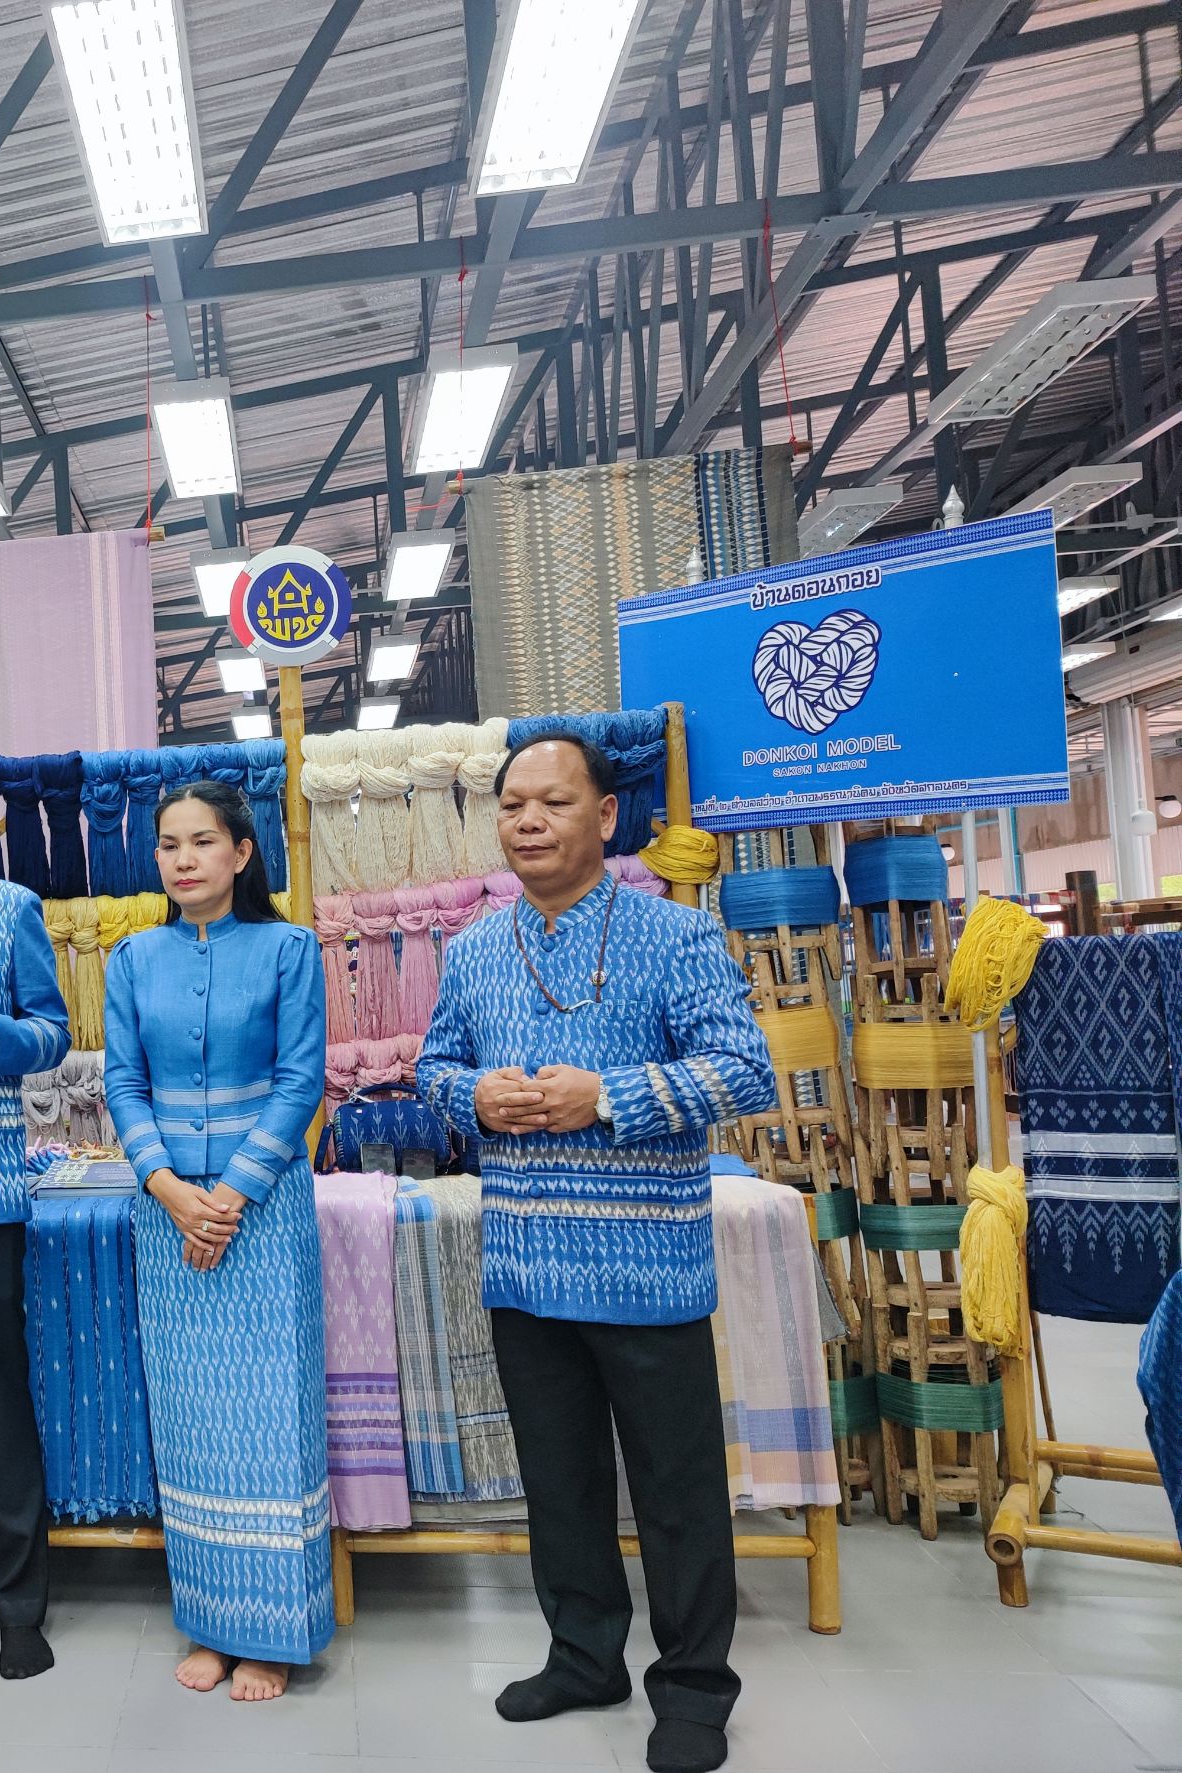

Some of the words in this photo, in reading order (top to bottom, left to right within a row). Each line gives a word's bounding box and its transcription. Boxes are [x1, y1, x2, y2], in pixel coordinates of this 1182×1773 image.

[751, 568, 881, 609] บ้านดอนกอย
[742, 742, 818, 767] DONKOI
[826, 734, 901, 757] MODEL
[773, 764, 812, 777] SAKON
[817, 759, 867, 773] NAKHON
[731, 793, 782, 810] ตำบลสว่าง
[785, 785, 877, 805] อำเภอพรรณานิคม
[881, 780, 968, 796] จังหวัดสกลนคร
